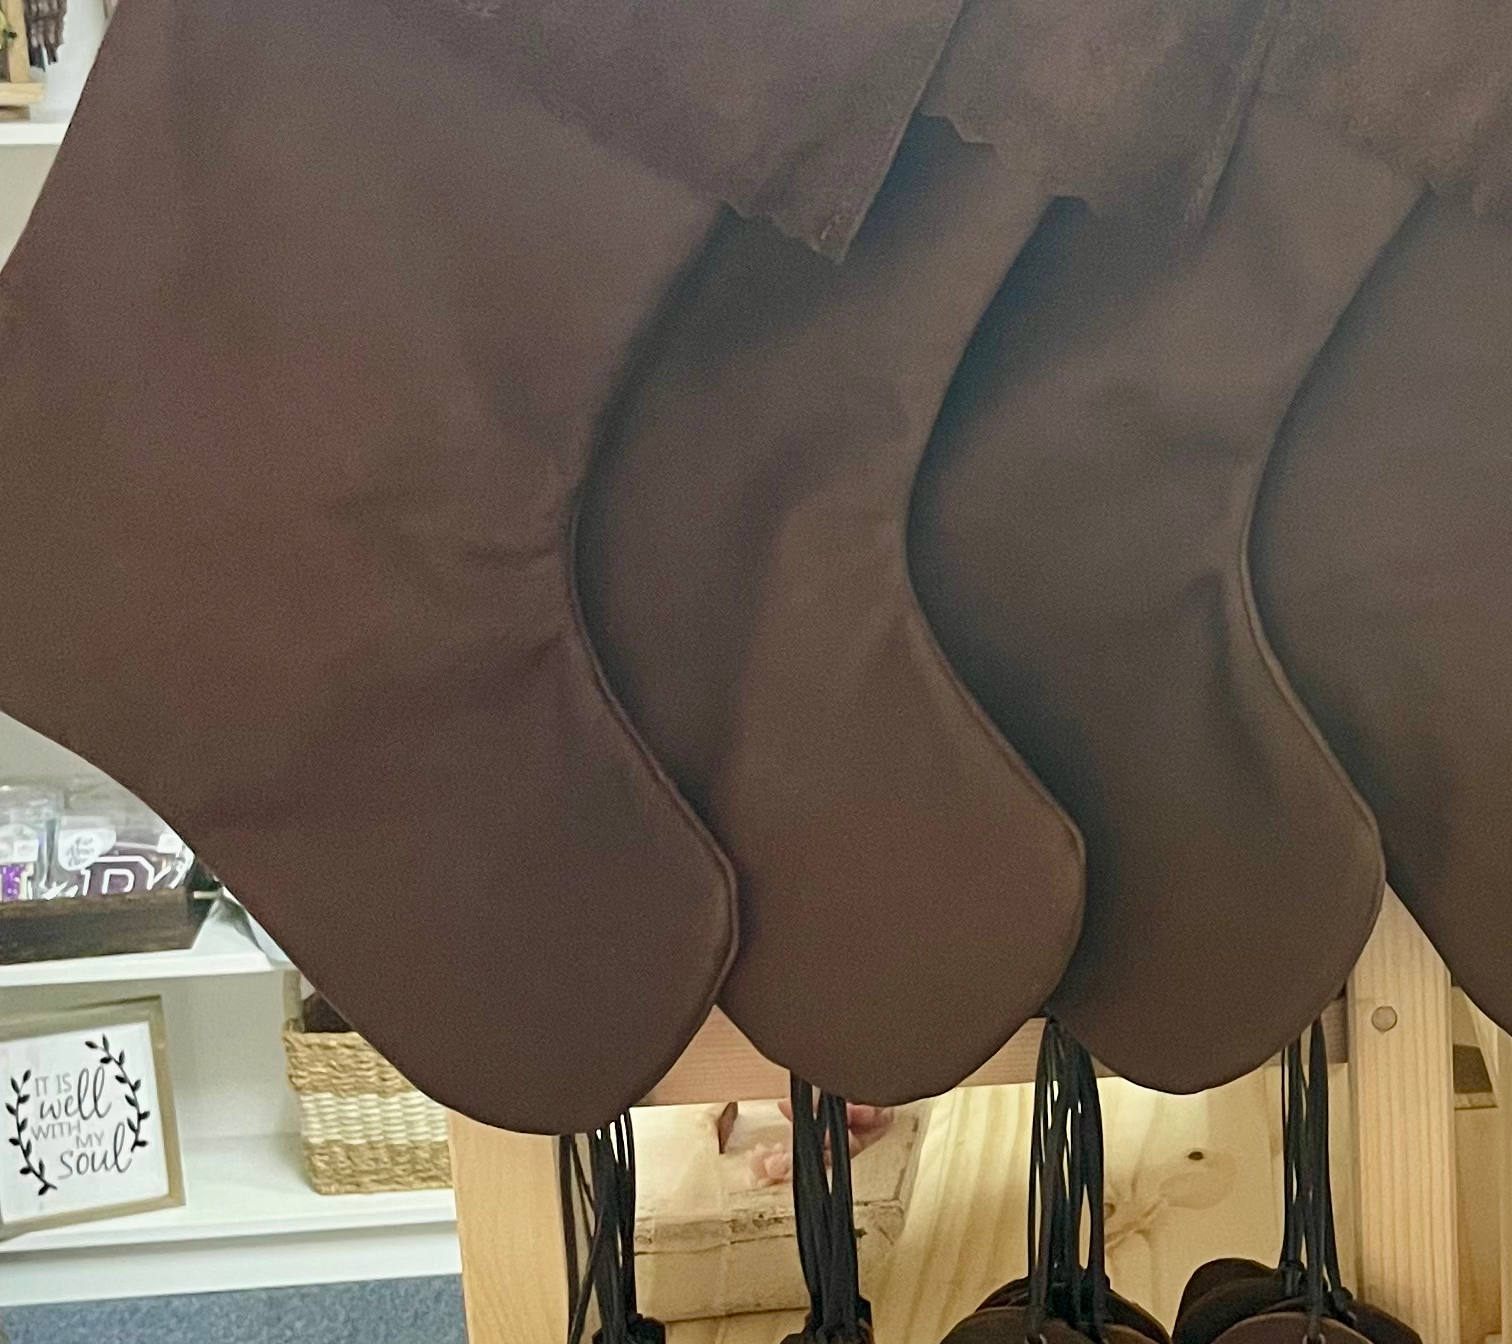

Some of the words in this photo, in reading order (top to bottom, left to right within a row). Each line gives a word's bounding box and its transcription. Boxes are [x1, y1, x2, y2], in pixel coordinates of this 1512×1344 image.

[34, 1075, 49, 1097] IT
[56, 1072, 72, 1095] IS
[39, 1065, 112, 1121] well
[30, 1119, 81, 1141] WITH
[75, 1130, 105, 1149] MY
